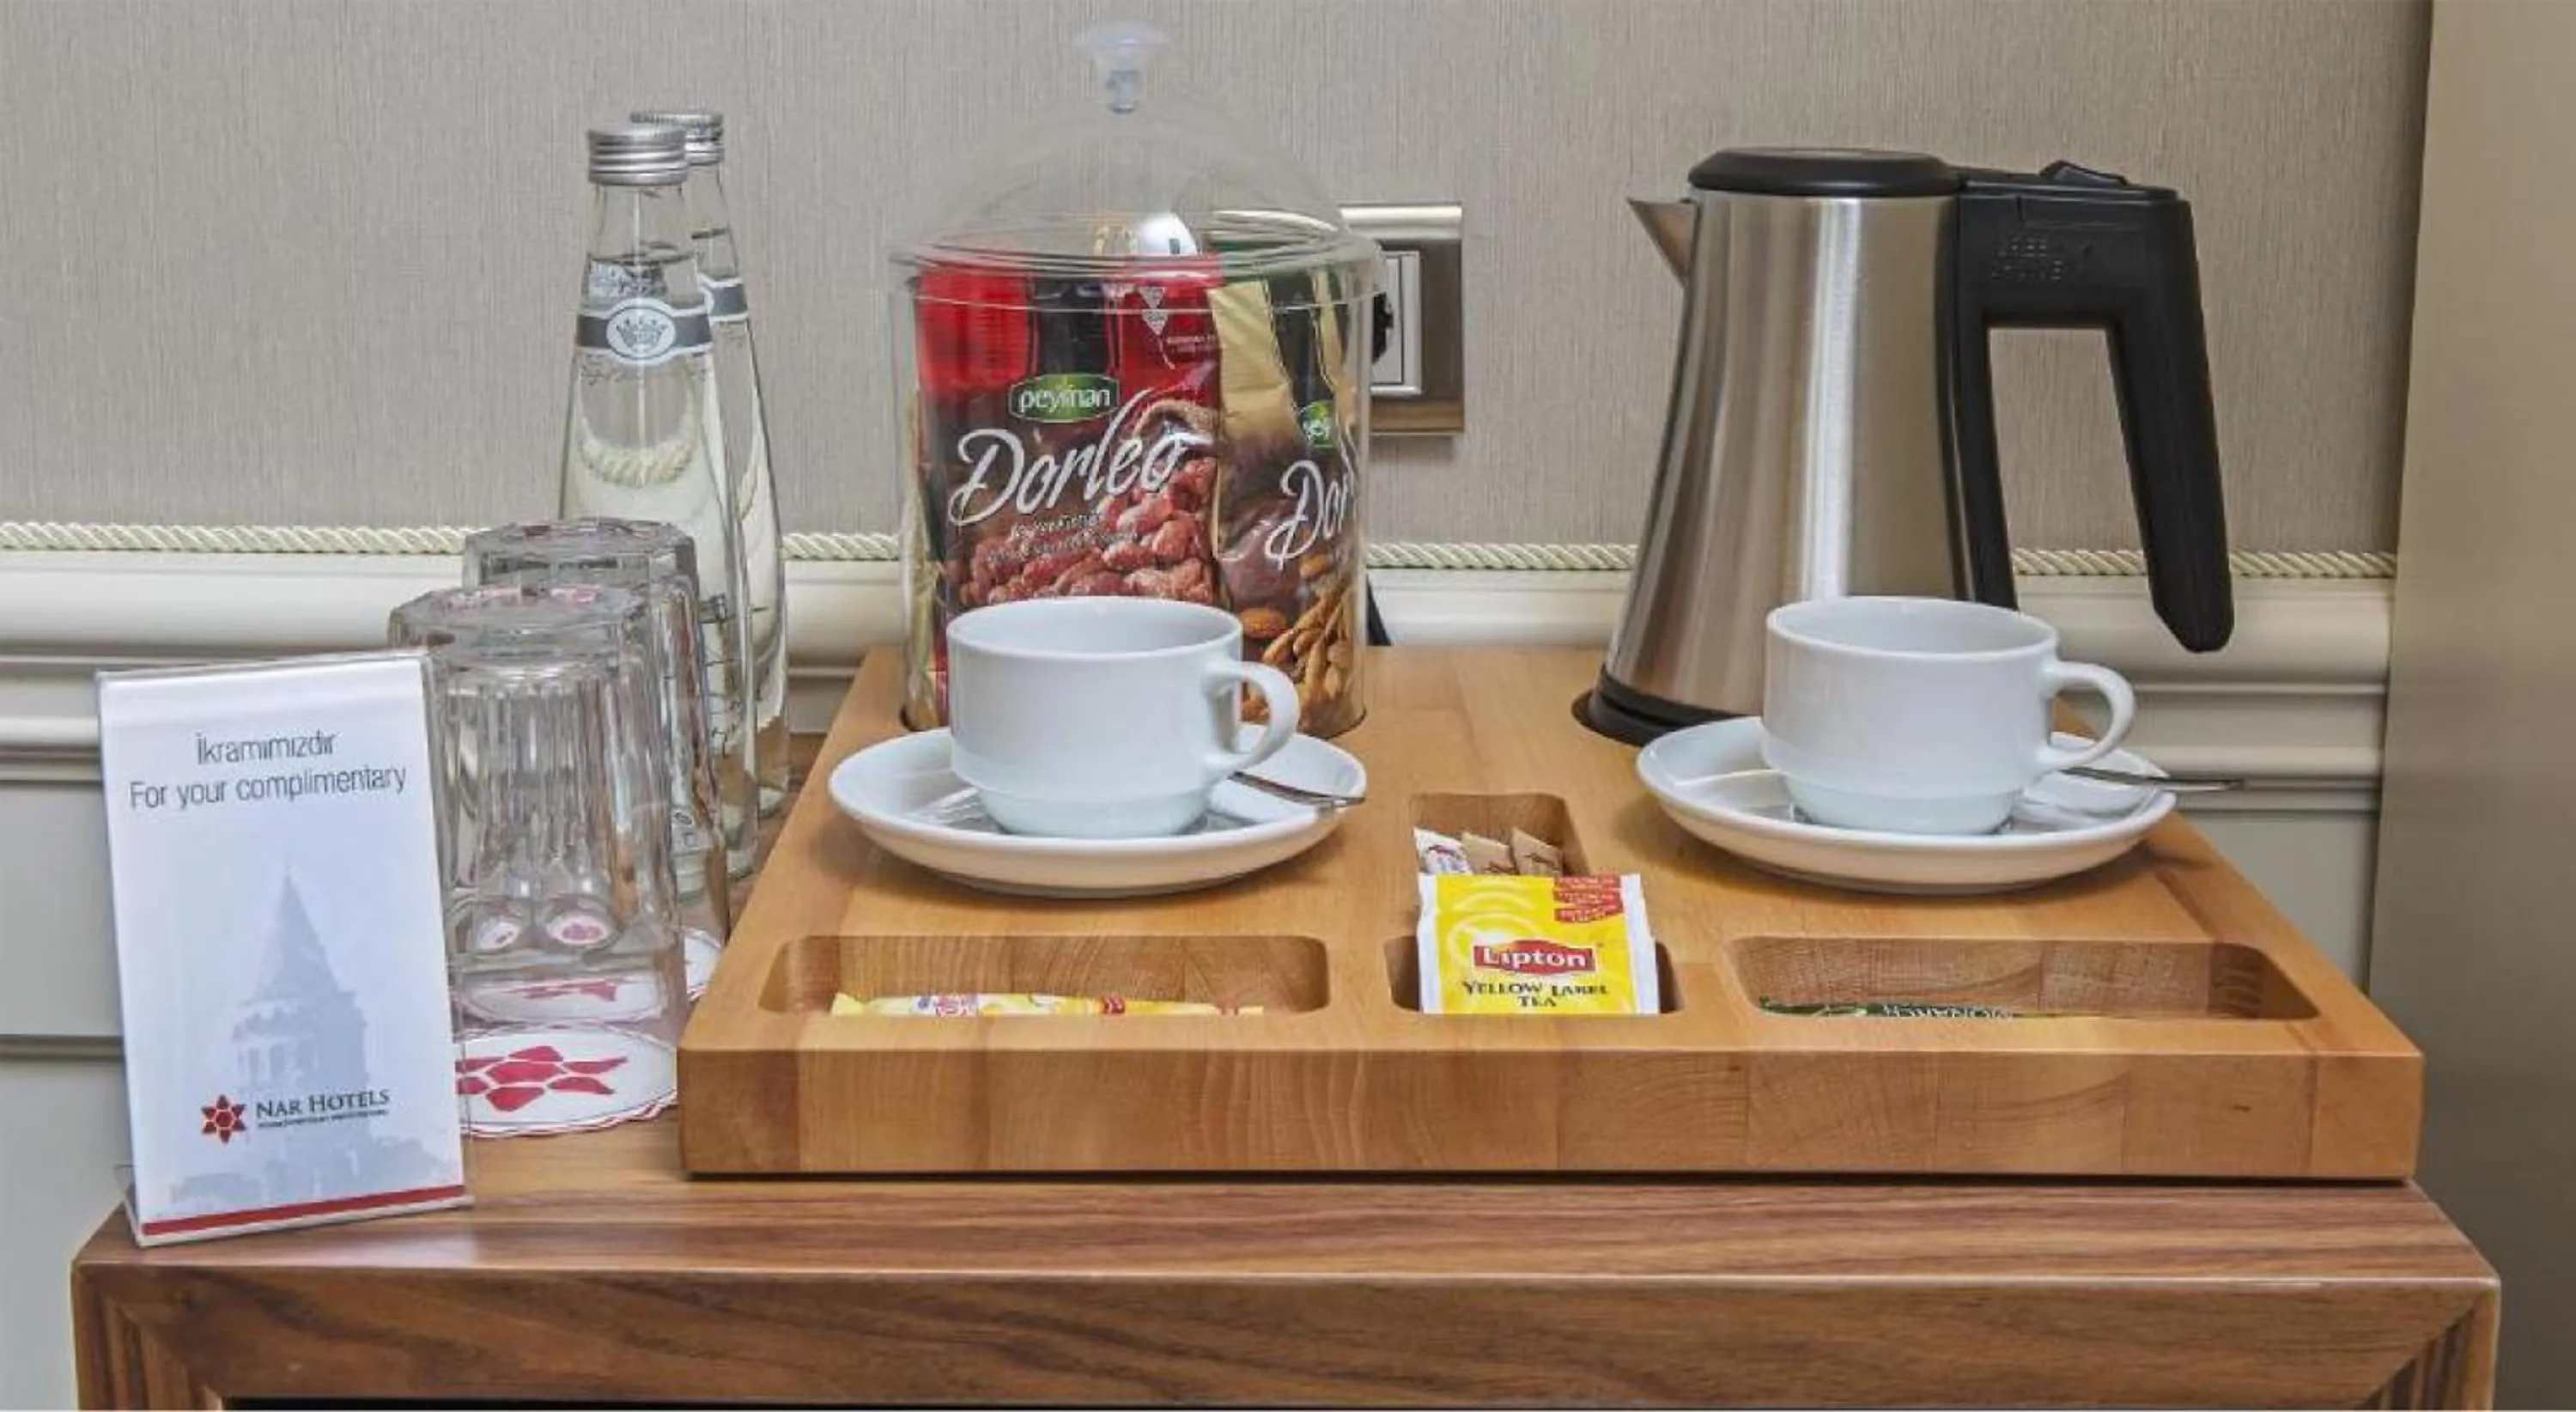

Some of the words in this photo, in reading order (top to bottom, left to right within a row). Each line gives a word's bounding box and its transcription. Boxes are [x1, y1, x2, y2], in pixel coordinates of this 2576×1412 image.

[947, 388, 1213, 533] Dorleo
[129, 781, 168, 810] For
[176, 778, 227, 810] your
[235, 764, 407, 802] complimentary
[1482, 947, 1587, 970] Lipton
[1461, 980, 1543, 995] YELLOW
[1550, 983, 1608, 997] LABEL
[1518, 995, 1558, 1007] TEA
[256, 1099, 302, 1119] NAR
[309, 1088, 392, 1113] HOTELS
